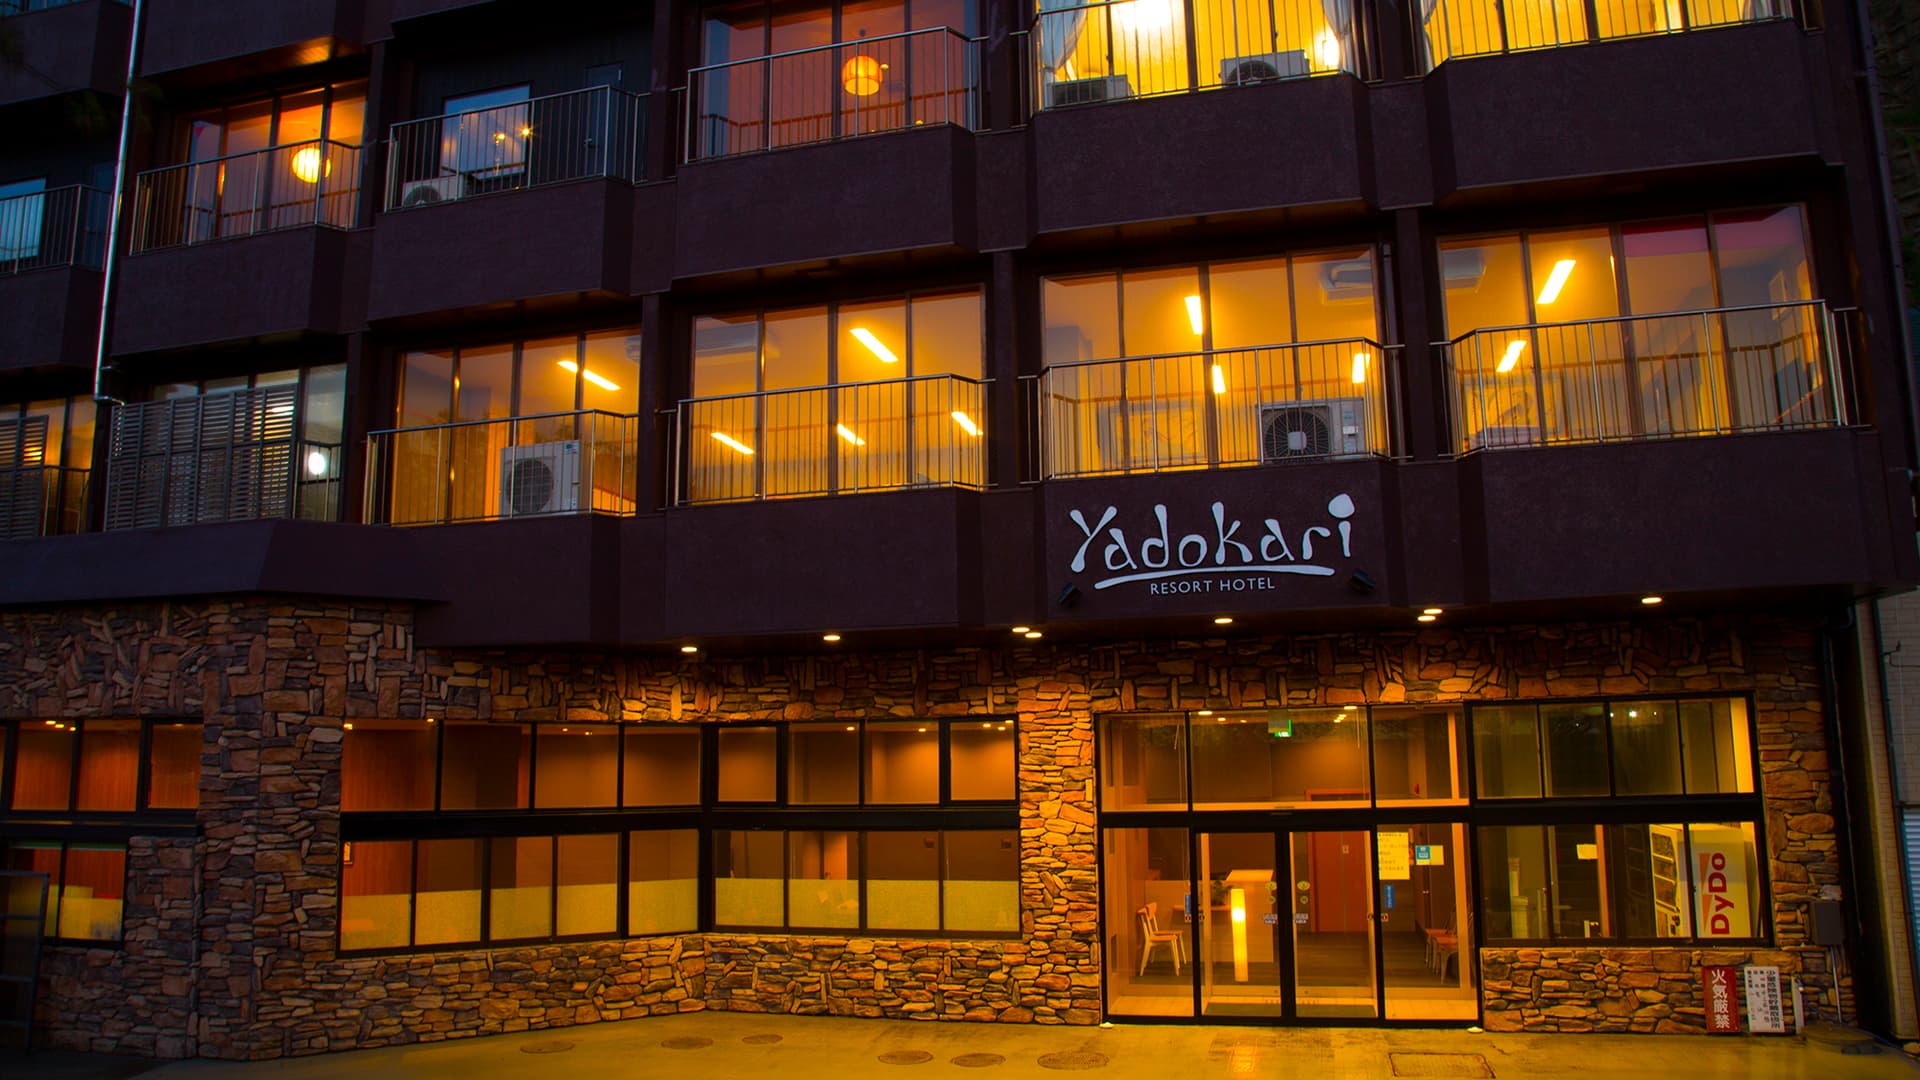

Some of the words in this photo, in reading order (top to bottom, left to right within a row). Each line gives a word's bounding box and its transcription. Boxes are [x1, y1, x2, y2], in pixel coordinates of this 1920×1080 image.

[1070, 493, 1355, 573] Yadokari
[1150, 579, 1213, 595] RESORT
[1219, 576, 1275, 592] HOTEL
[1708, 852, 1734, 935] DyDo
[1711, 969, 1730, 1029] 火気厳禁
